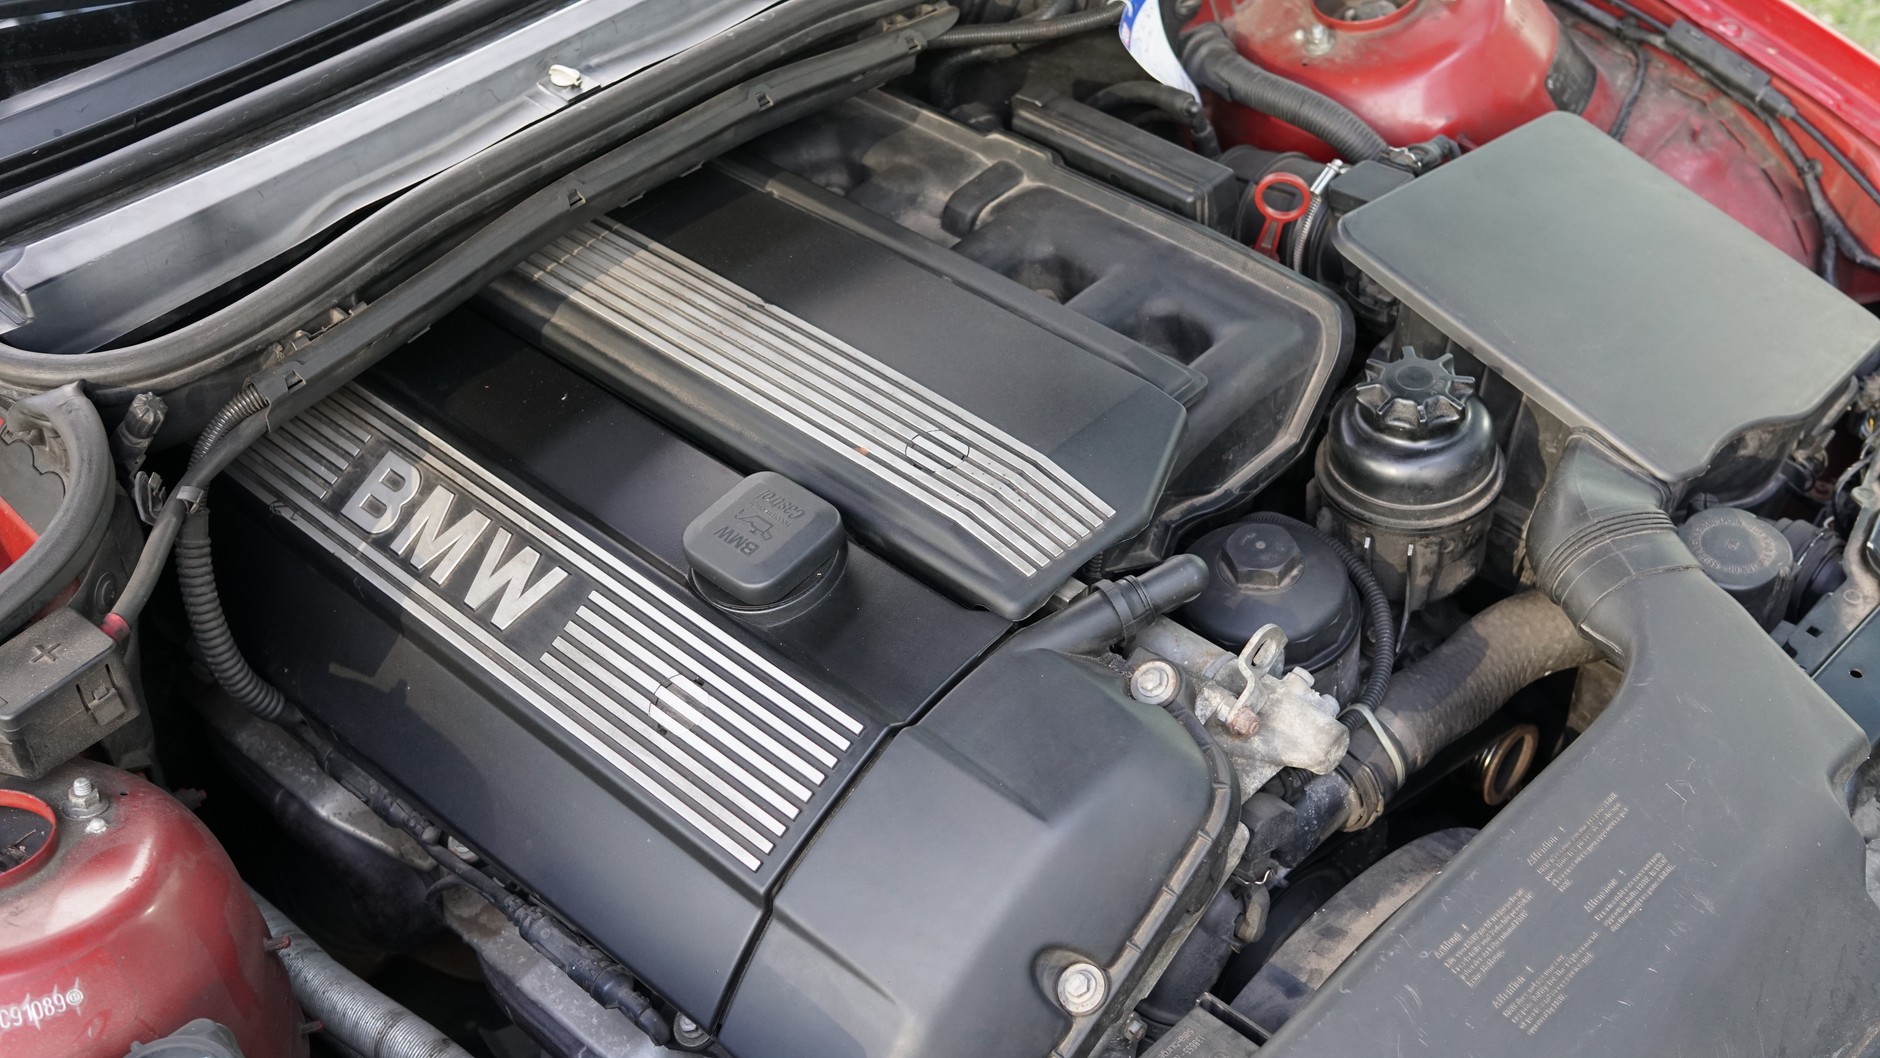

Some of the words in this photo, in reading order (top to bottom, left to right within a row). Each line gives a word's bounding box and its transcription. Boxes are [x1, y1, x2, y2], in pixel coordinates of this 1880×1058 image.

[756, 489, 805, 519] Castrol
[340, 450, 571, 631] BMW
[713, 525, 760, 557] BMW
[1492, 974, 1524, 1007] Attention
